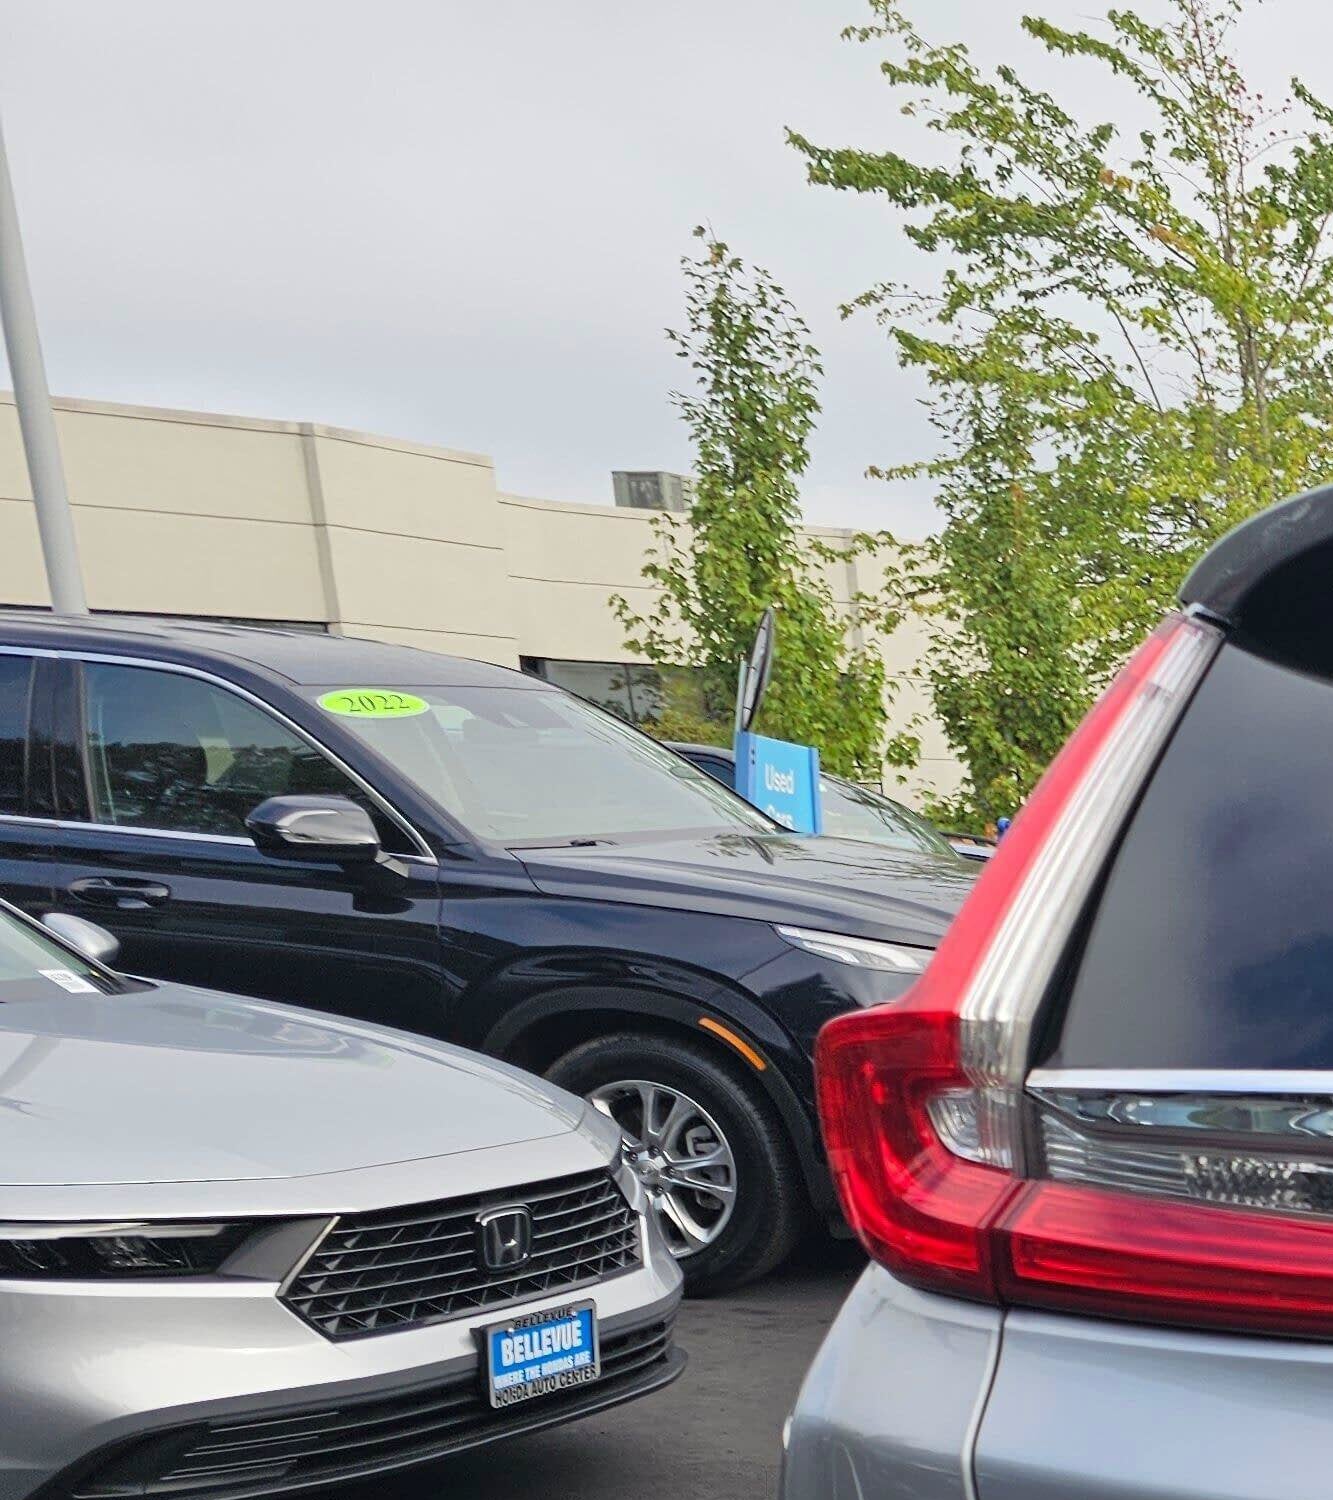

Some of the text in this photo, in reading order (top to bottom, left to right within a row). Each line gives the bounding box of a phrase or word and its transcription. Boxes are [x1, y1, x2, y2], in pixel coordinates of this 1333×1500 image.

[340, 694, 410, 712] 2022
[764, 763, 794, 794] Used
[501, 1319, 582, 1367] BELLEVUE
[530, 1375, 556, 1396] AUTO
